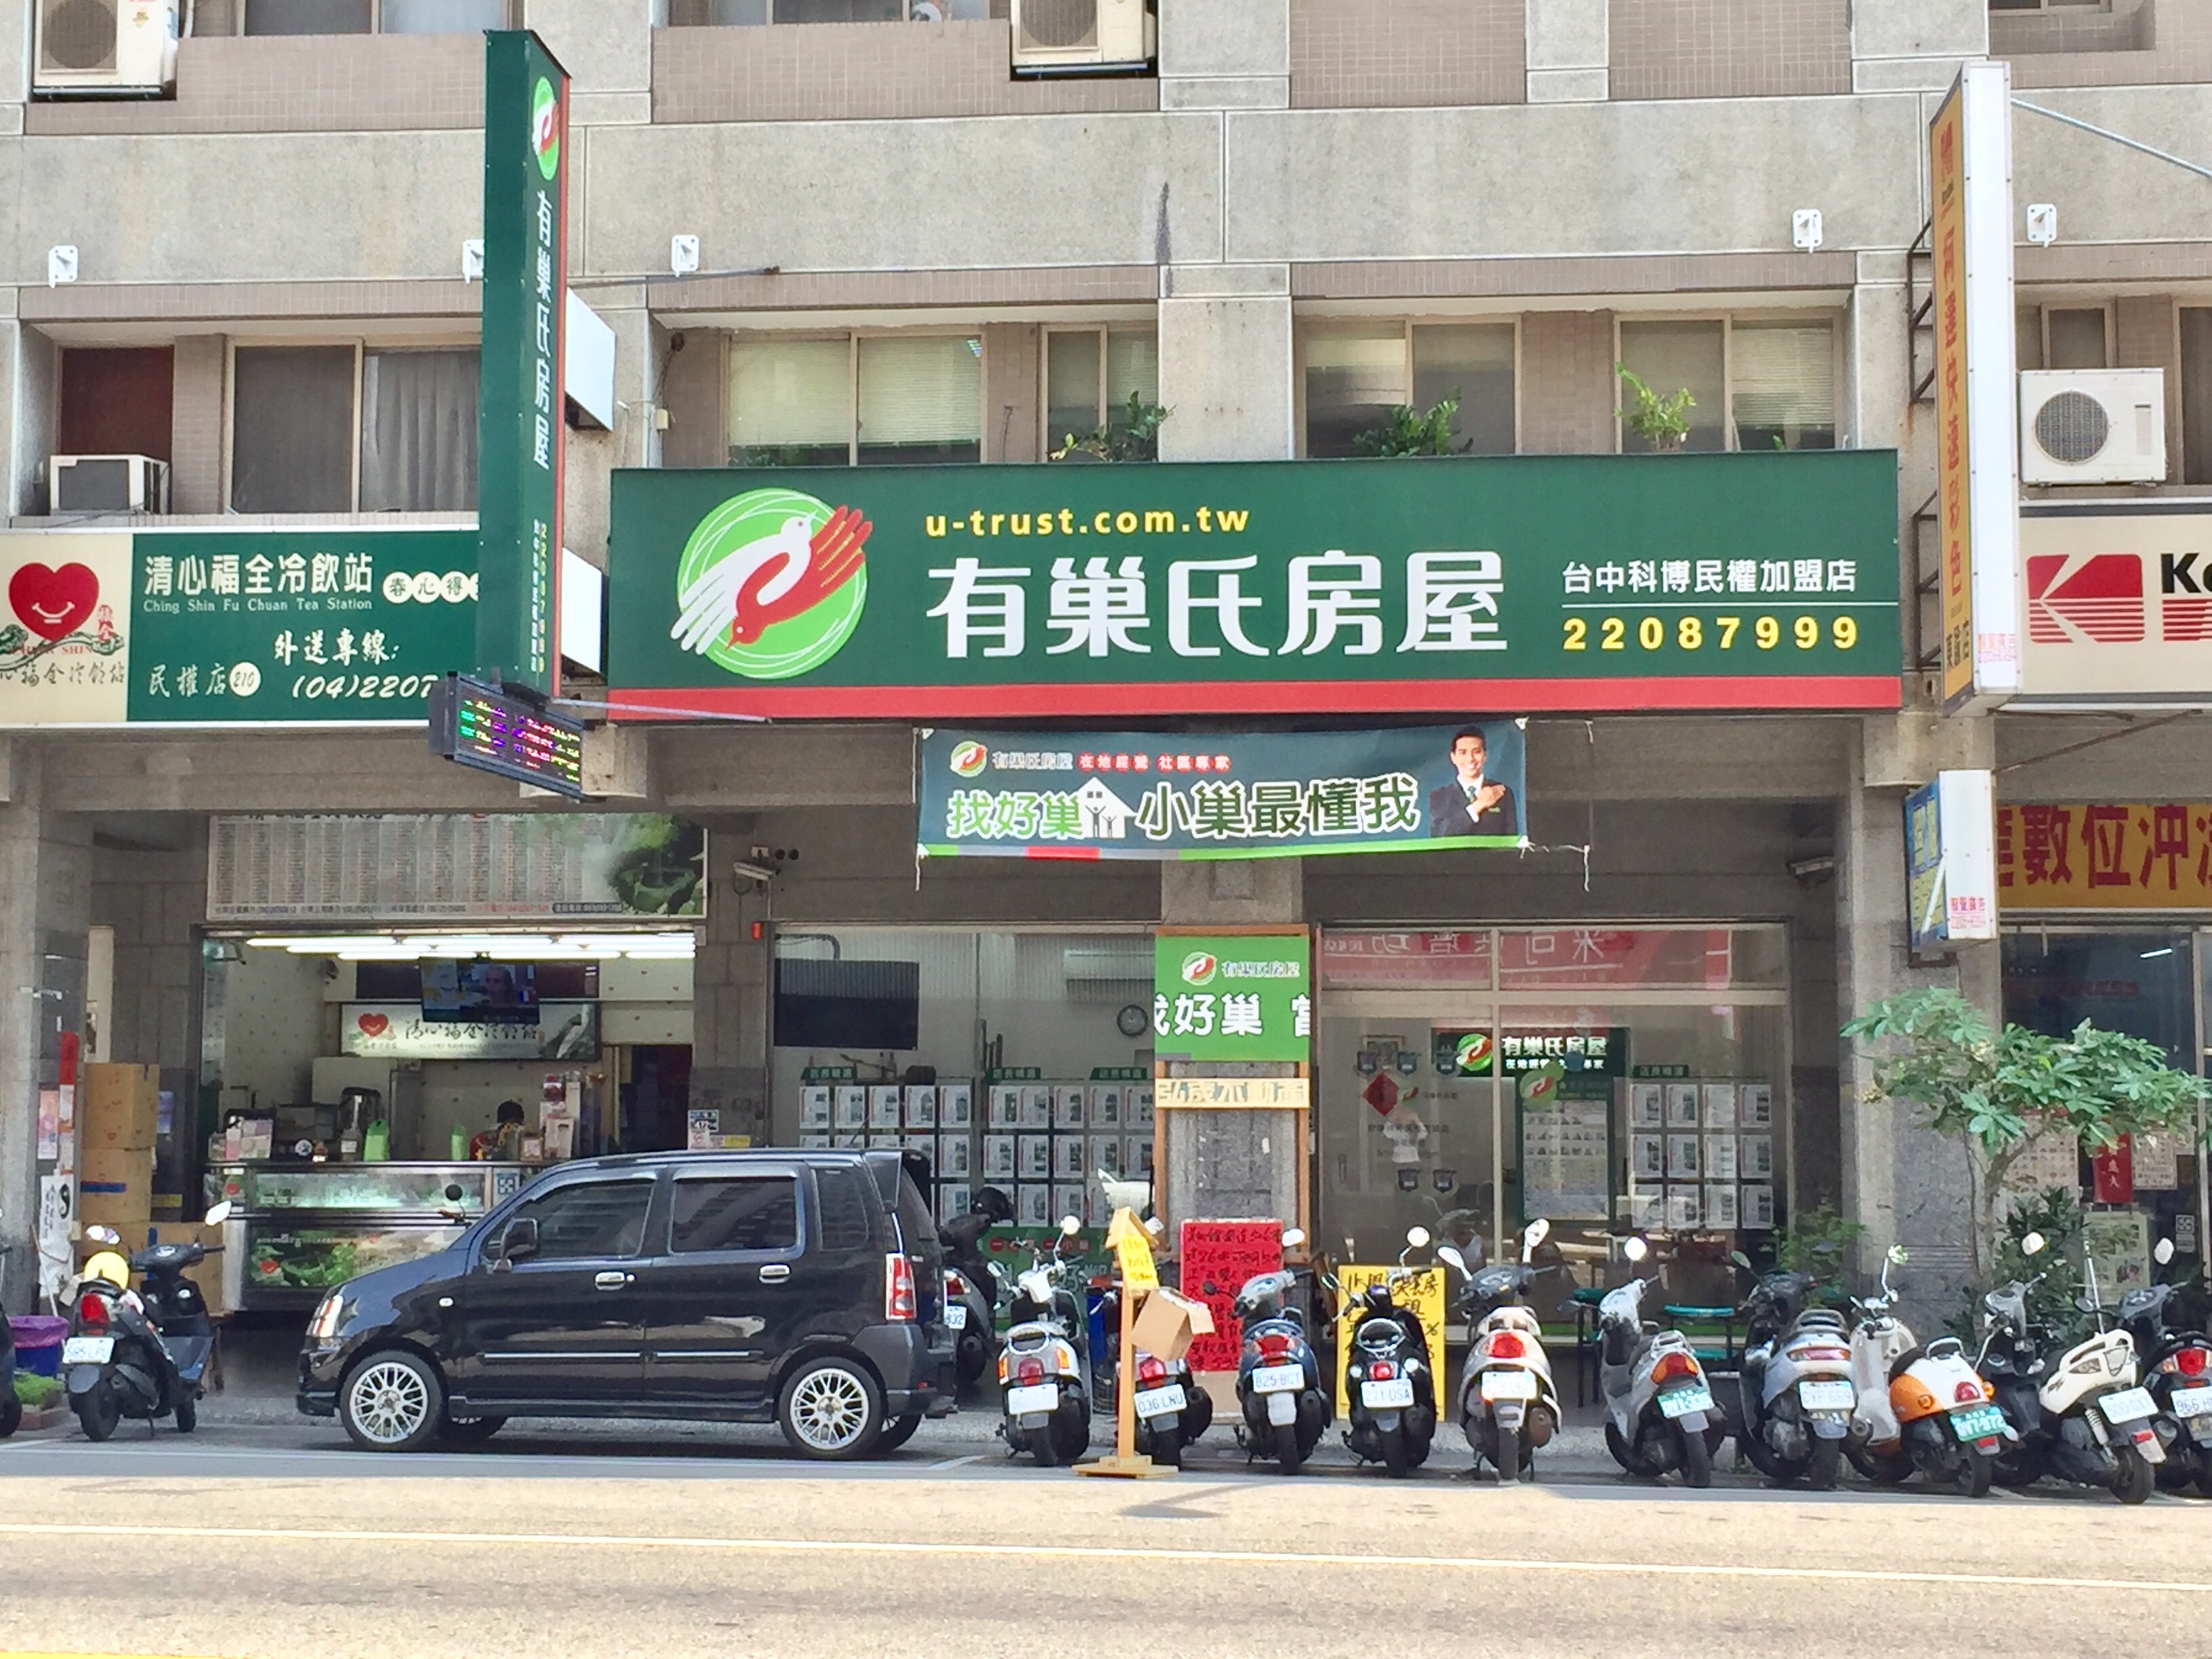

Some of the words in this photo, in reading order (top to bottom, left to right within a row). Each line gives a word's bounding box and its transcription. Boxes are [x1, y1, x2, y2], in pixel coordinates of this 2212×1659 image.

[533, 190, 554, 470] 有巢氏房屋
[926, 505, 1250, 537] u-trust.com.tw
[143, 552, 373, 596] 清心福全冷飲站
[389, 576, 478, 597] 春心得
[1561, 559, 1857, 594] 台中科博民權加盟店
[2161, 553, 2212, 594] K
[144, 599, 180, 614] Ching
[187, 598, 215, 611] Shin
[224, 598, 239, 611] Fu
[247, 598, 287, 611] Chuan
[297, 597, 319, 610] Tea
[327, 596, 372, 610] Station
[926, 550, 1509, 659] 有巢氏房屋
[1563, 616, 1858, 651] 22087999
[148, 663, 226, 698] 民權店
[946, 790, 1084, 840] 找好巢
[1135, 771, 1420, 840] 小巢最懂我
